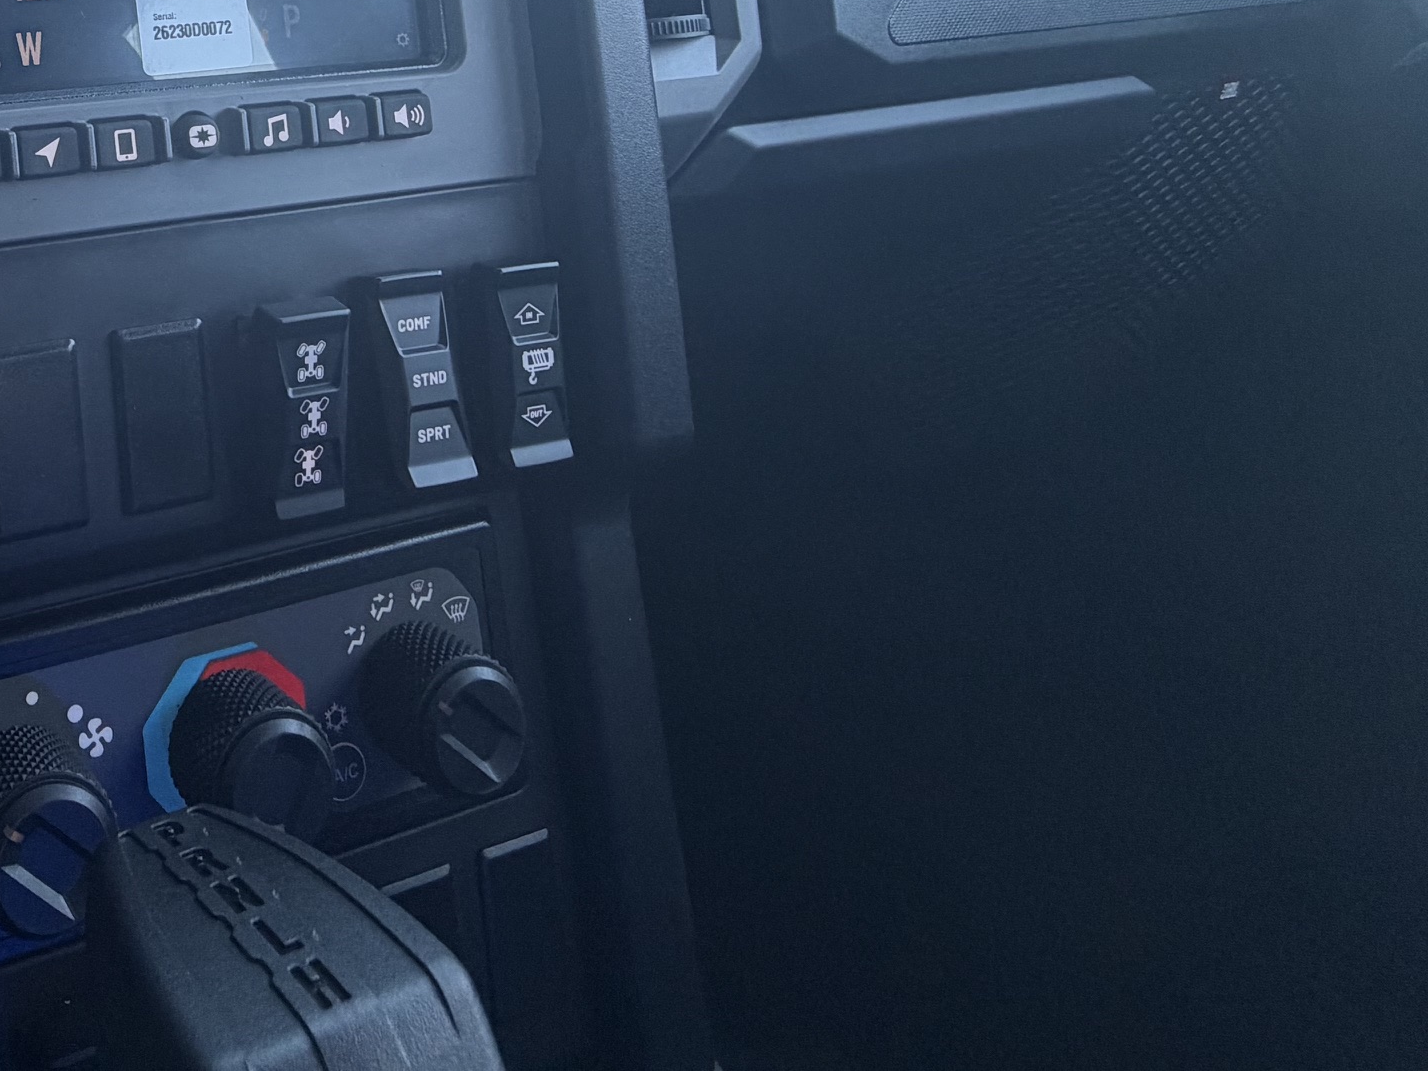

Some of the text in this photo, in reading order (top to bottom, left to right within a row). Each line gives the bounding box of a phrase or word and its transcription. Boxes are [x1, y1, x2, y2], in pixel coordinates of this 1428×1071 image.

[153, 12, 177, 21] Serial:
[283, 4, 300, 39] P
[153, 20, 233, 40] 26230D0072
[16, 31, 42, 66] W
[397, 315, 431, 332] COMF
[412, 370, 447, 388] STND
[530, 409, 543, 419] OUT
[417, 425, 451, 443] SPRT
